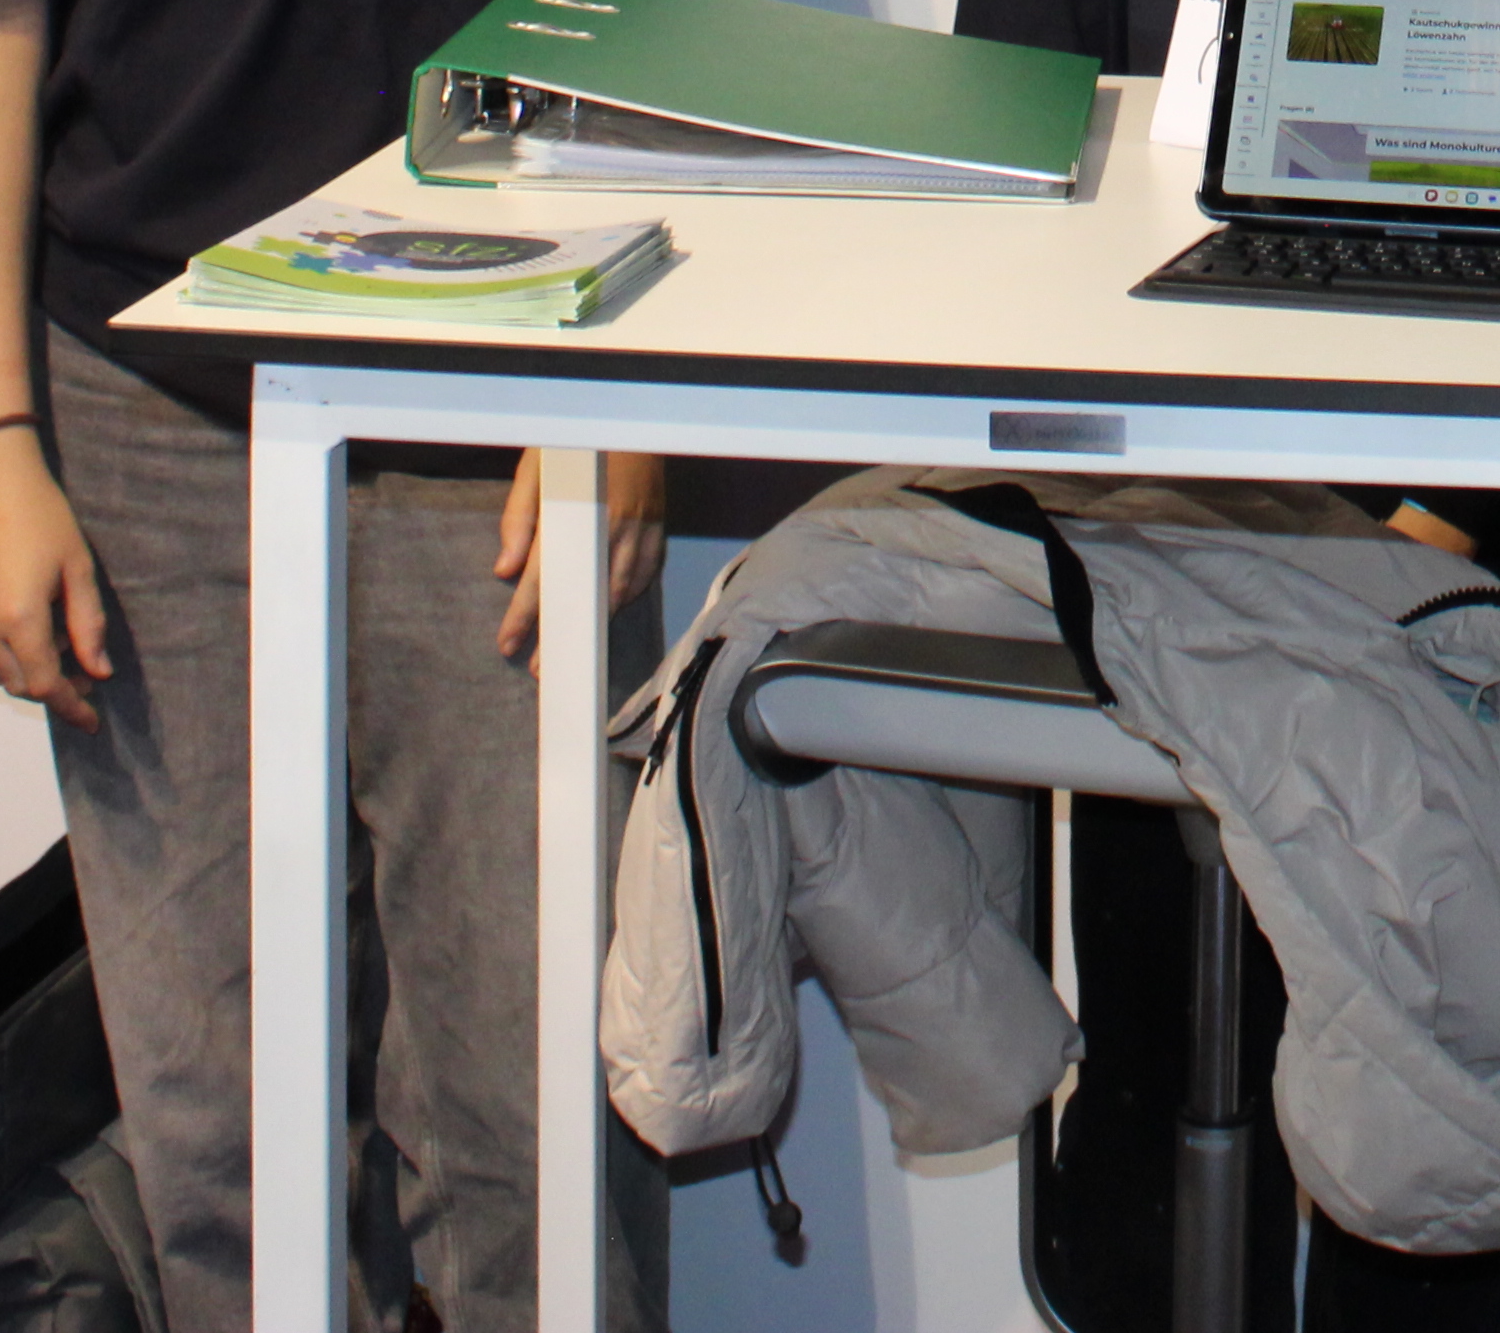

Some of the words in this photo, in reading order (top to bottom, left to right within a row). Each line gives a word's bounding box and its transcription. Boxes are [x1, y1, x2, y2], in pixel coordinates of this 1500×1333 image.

[1407, 30, 1467, 42] Löwenzahn
[1375, 137, 1400, 148] Was
[1402, 139, 1427, 150] sind
